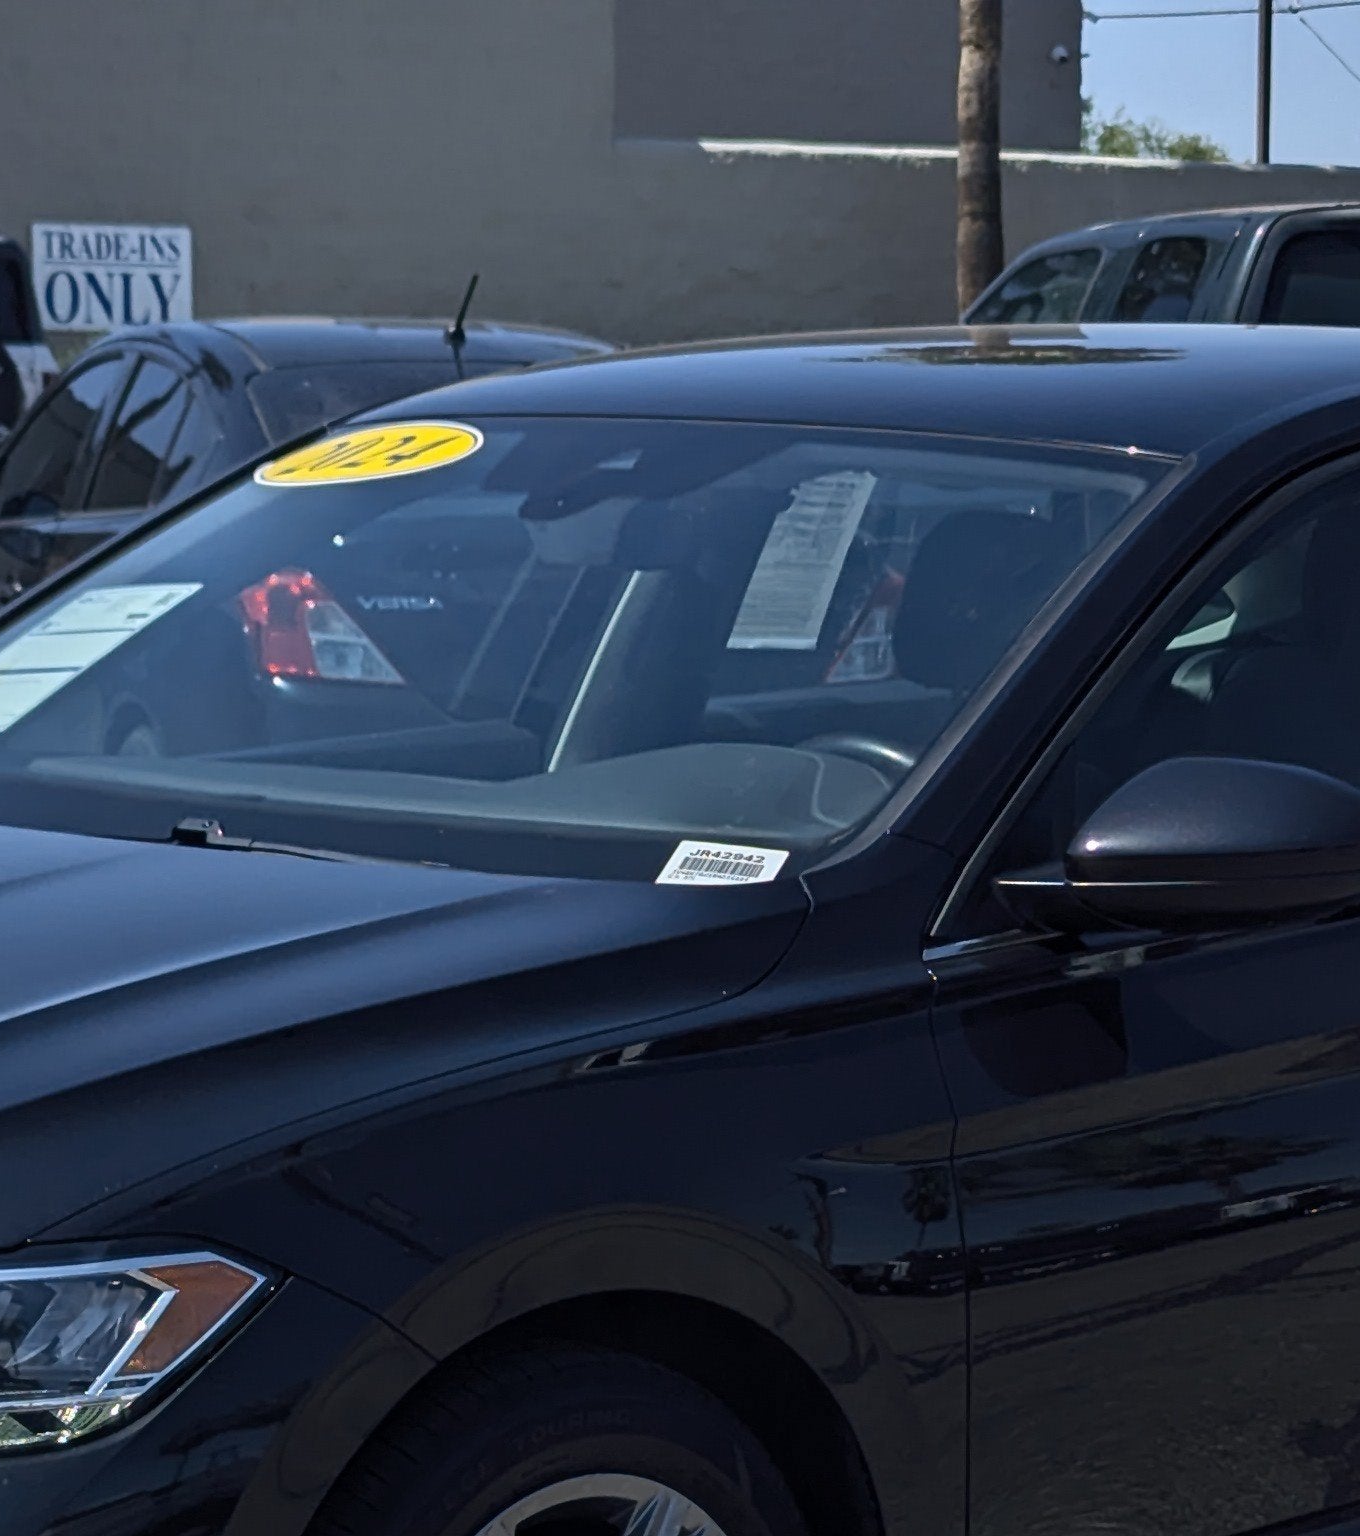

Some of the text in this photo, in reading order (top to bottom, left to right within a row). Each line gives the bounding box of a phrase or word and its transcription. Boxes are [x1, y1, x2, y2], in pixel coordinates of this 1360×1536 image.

[42, 230, 182, 263] TRADE-INS
[44, 270, 182, 325] ONLY
[274, 434, 463, 477] 2024
[356, 595, 444, 610] VERSA
